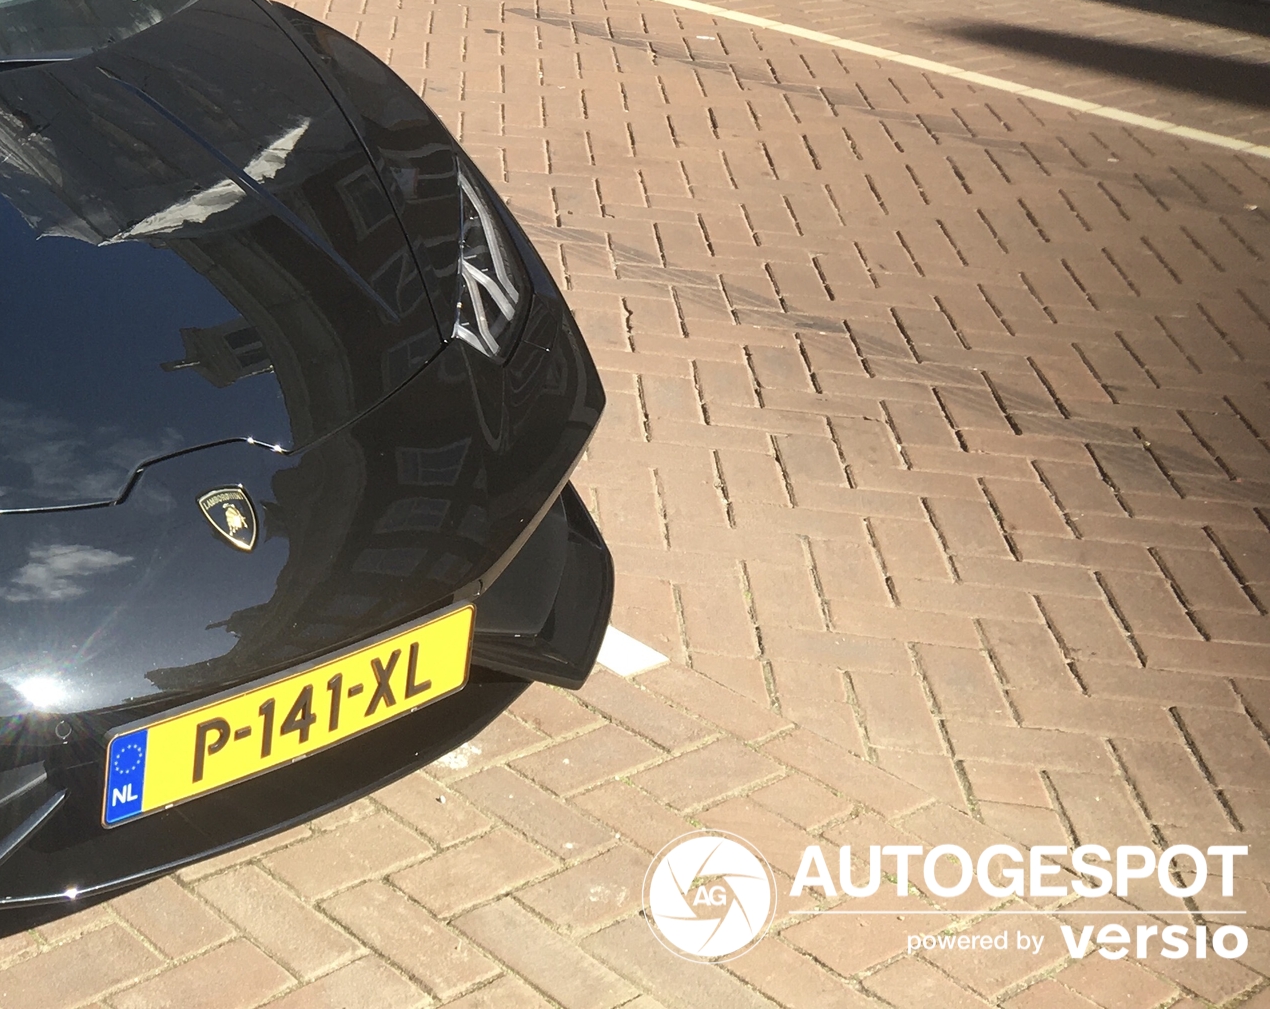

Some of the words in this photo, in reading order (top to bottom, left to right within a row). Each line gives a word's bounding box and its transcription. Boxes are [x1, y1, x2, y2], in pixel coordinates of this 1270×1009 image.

[203, 492, 244, 510] LAMBORGHINI
[192, 641, 433, 784] P-141-XL
[111, 783, 139, 807] NL
